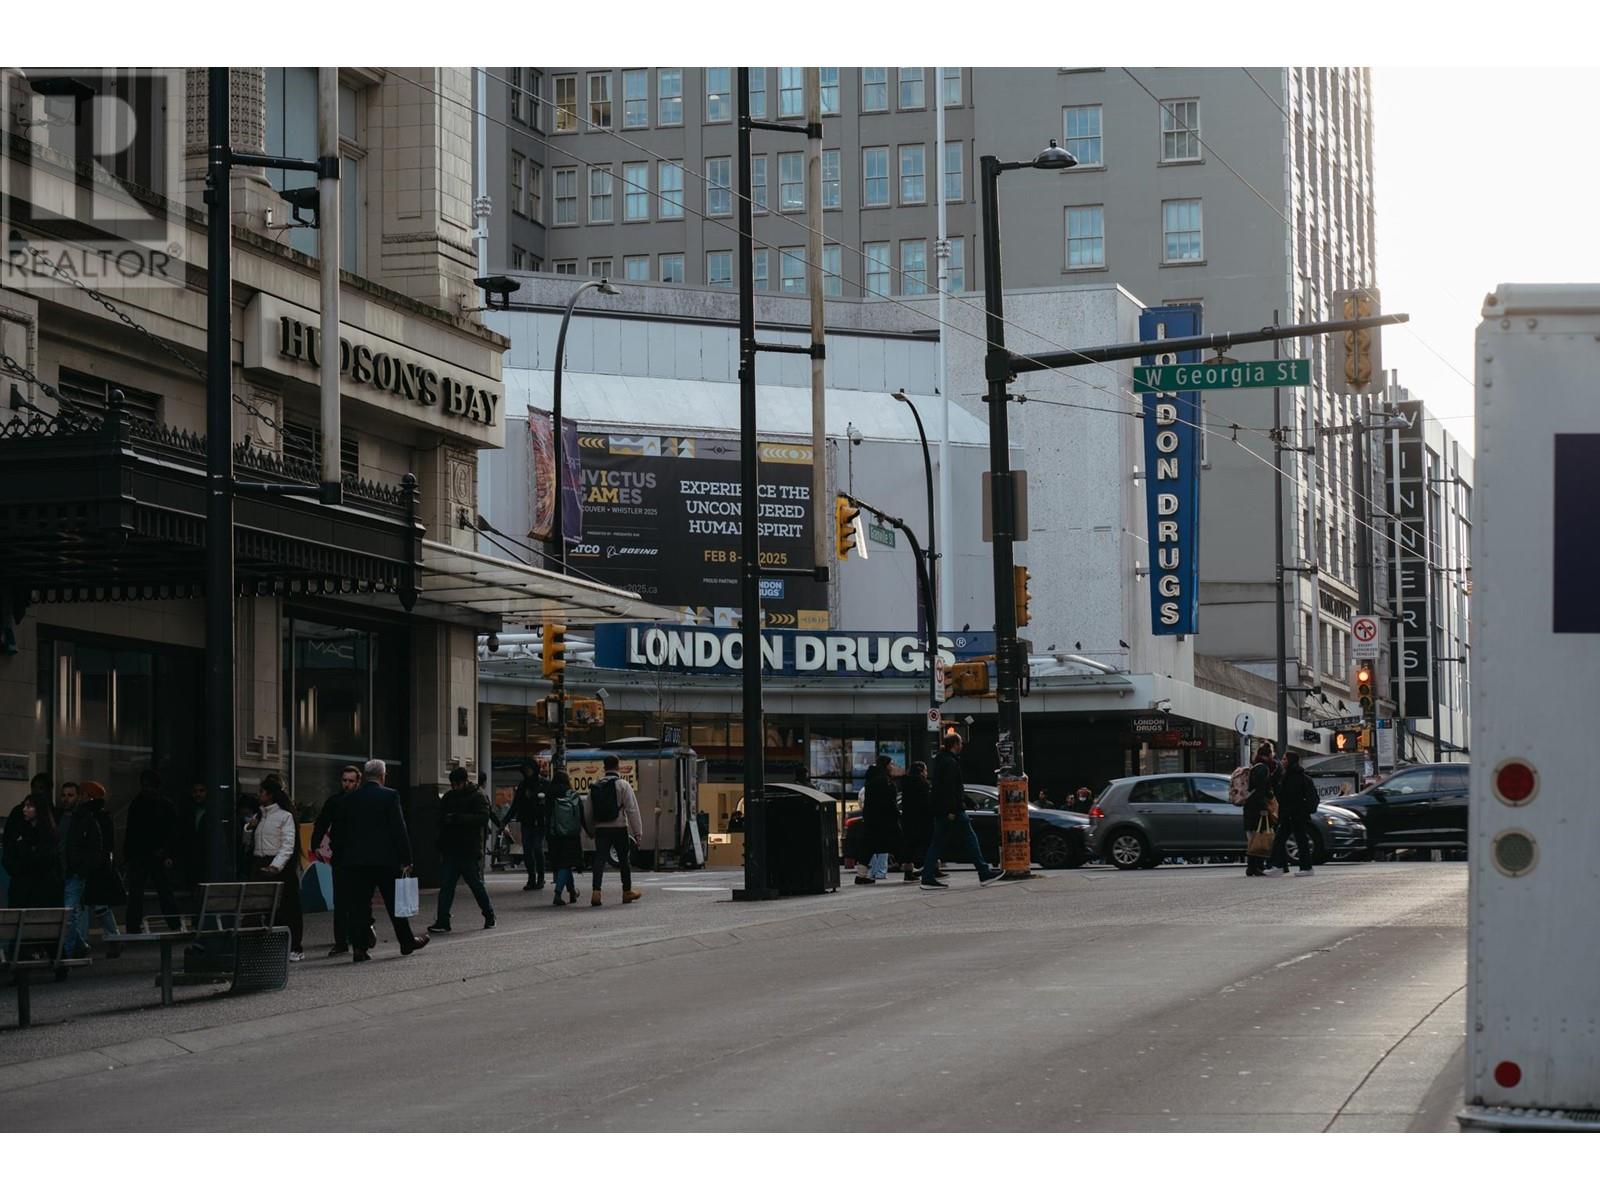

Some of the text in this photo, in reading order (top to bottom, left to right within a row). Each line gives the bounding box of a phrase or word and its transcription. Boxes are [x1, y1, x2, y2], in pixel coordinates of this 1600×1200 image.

[1146, 362, 1298, 387] W Georgia St
[443, 377, 498, 427] BAY
[680, 480, 810, 499] EXPERIECE THE
[612, 506, 642, 515] WHISTLER
[686, 500, 805, 518] UNCONUERED
[619, 547, 658, 556] BOEING
[704, 550, 726, 562] FEB
[759, 553, 787, 565] 2025
[1157, 493, 1180, 625] DRUGS
[630, 628, 783, 670] LONDON
